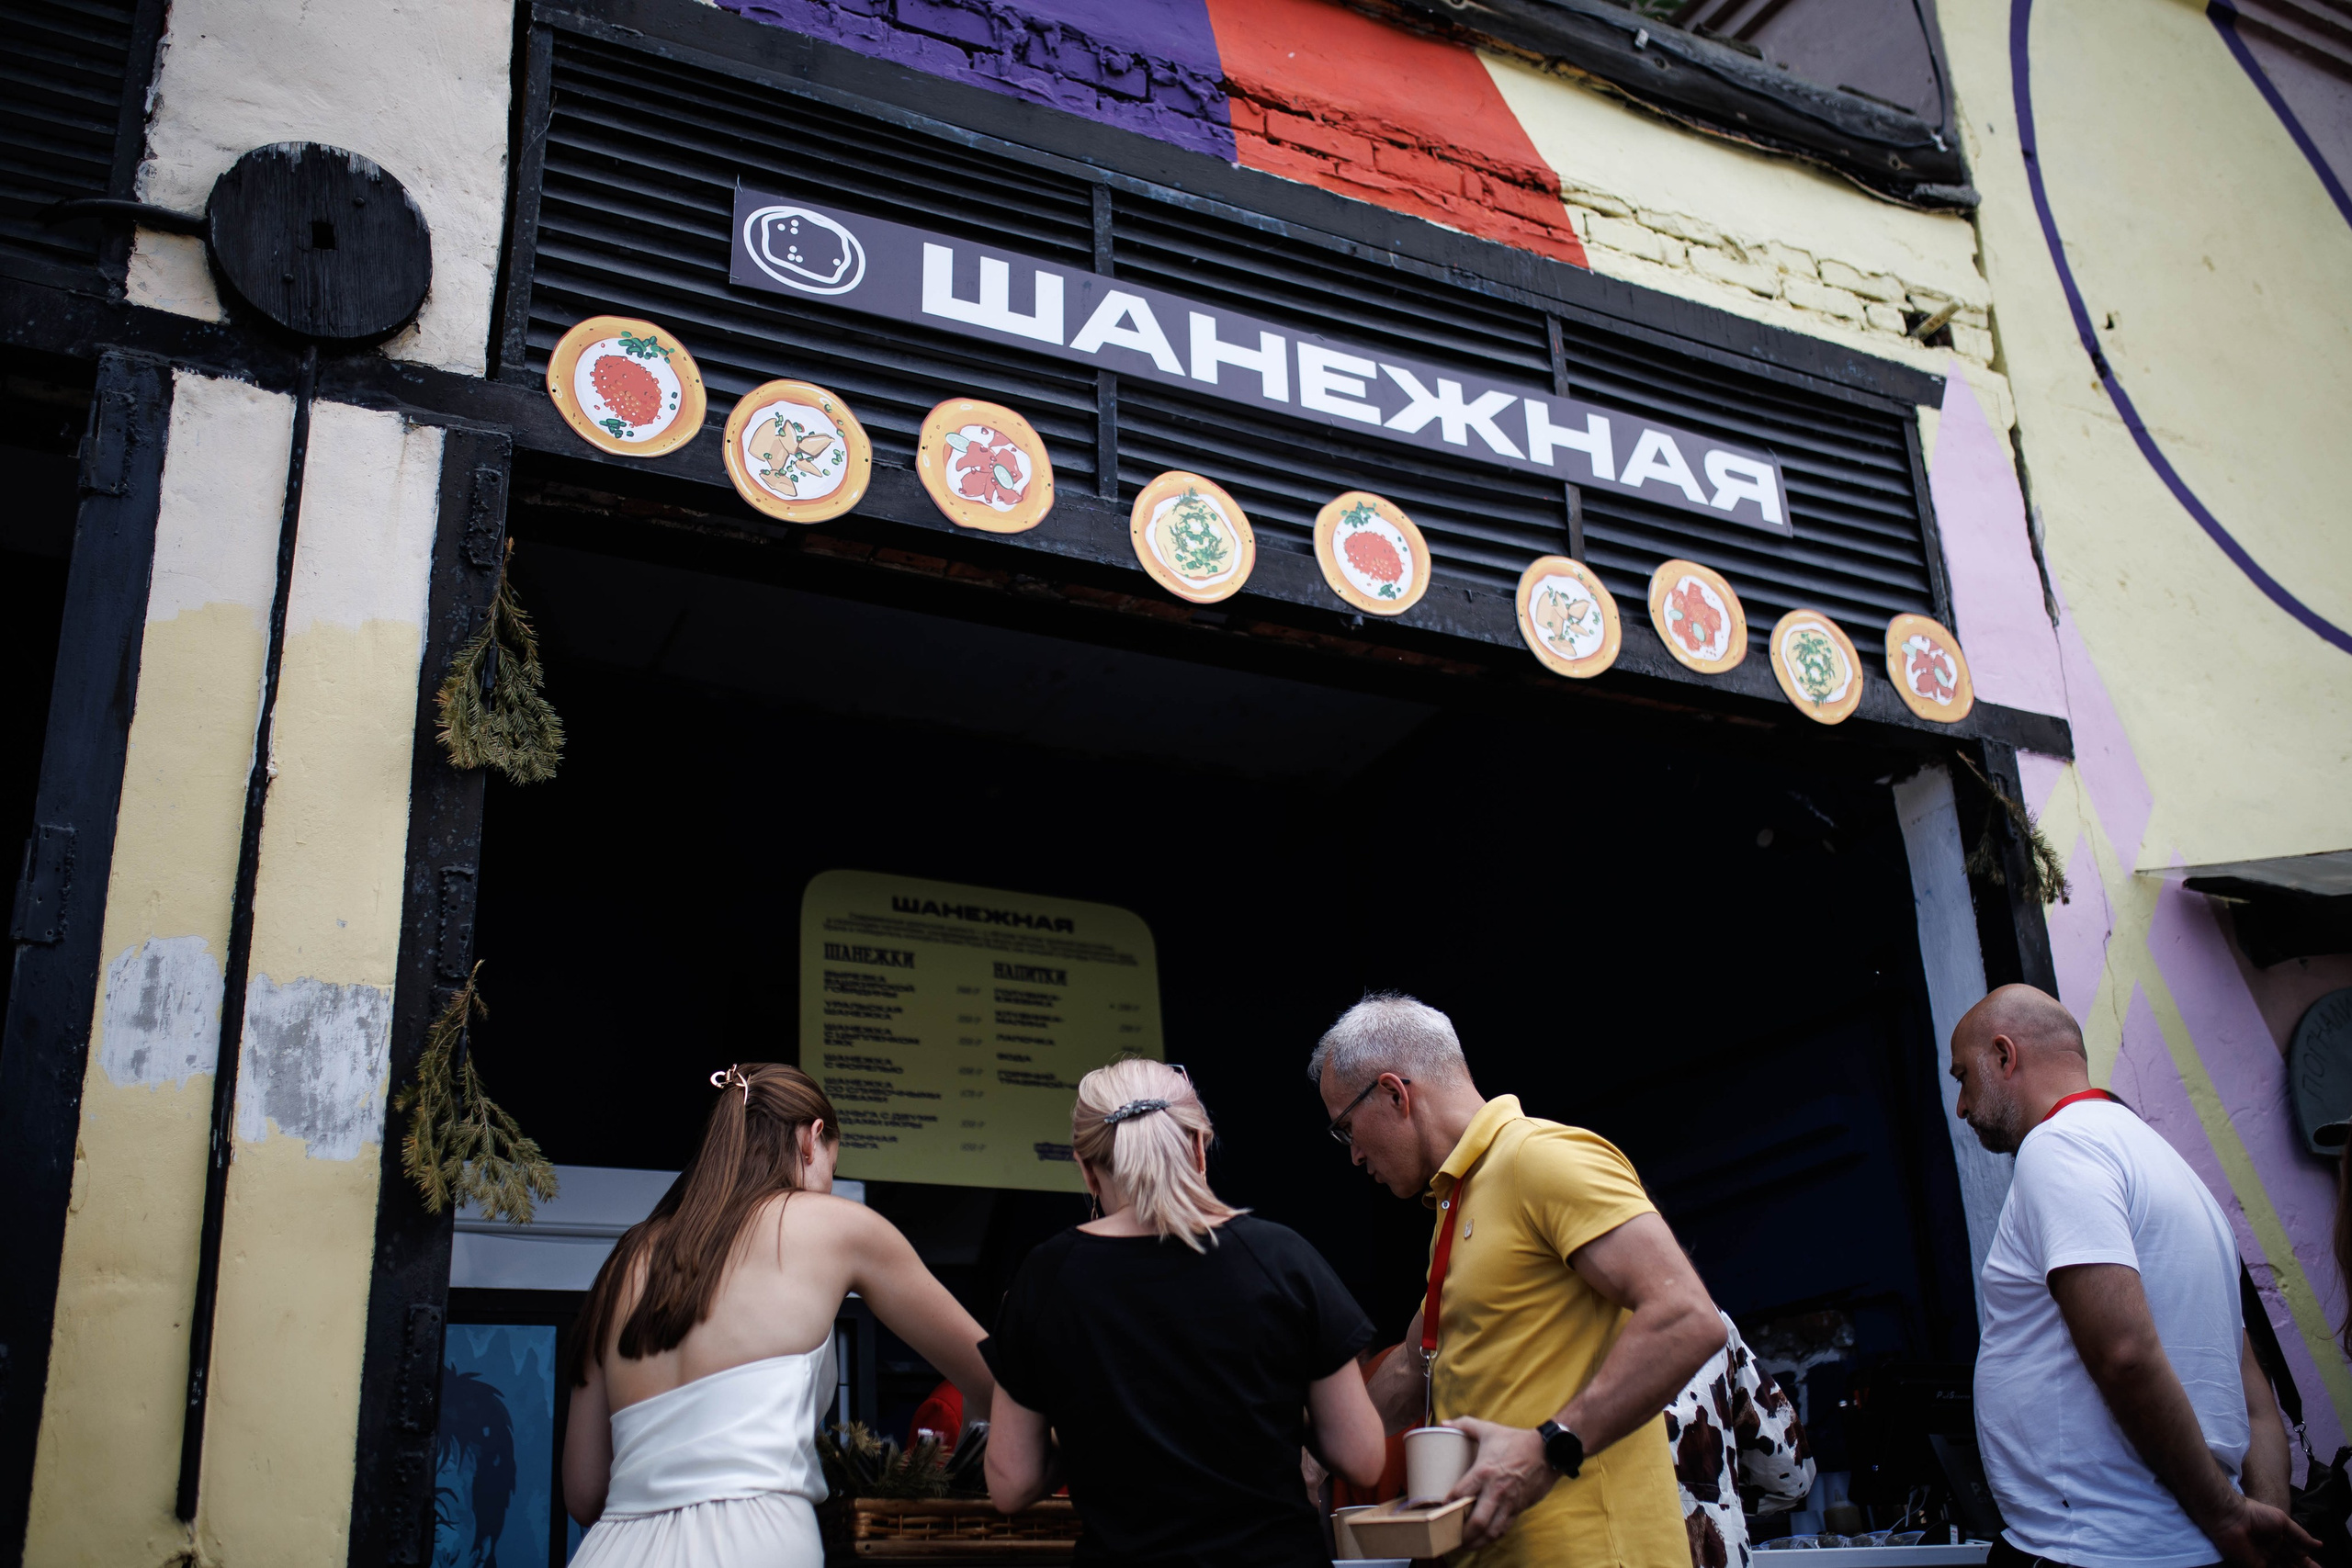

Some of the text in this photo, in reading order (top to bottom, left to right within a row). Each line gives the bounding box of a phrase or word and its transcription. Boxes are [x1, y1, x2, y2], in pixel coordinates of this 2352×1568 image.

[921, 241, 1782, 525] ШАНЕЖНАЯ
[892, 895, 1075, 934] ШАНЕЖНАЯ
[824, 942, 915, 969] ШАНЕЖКИ
